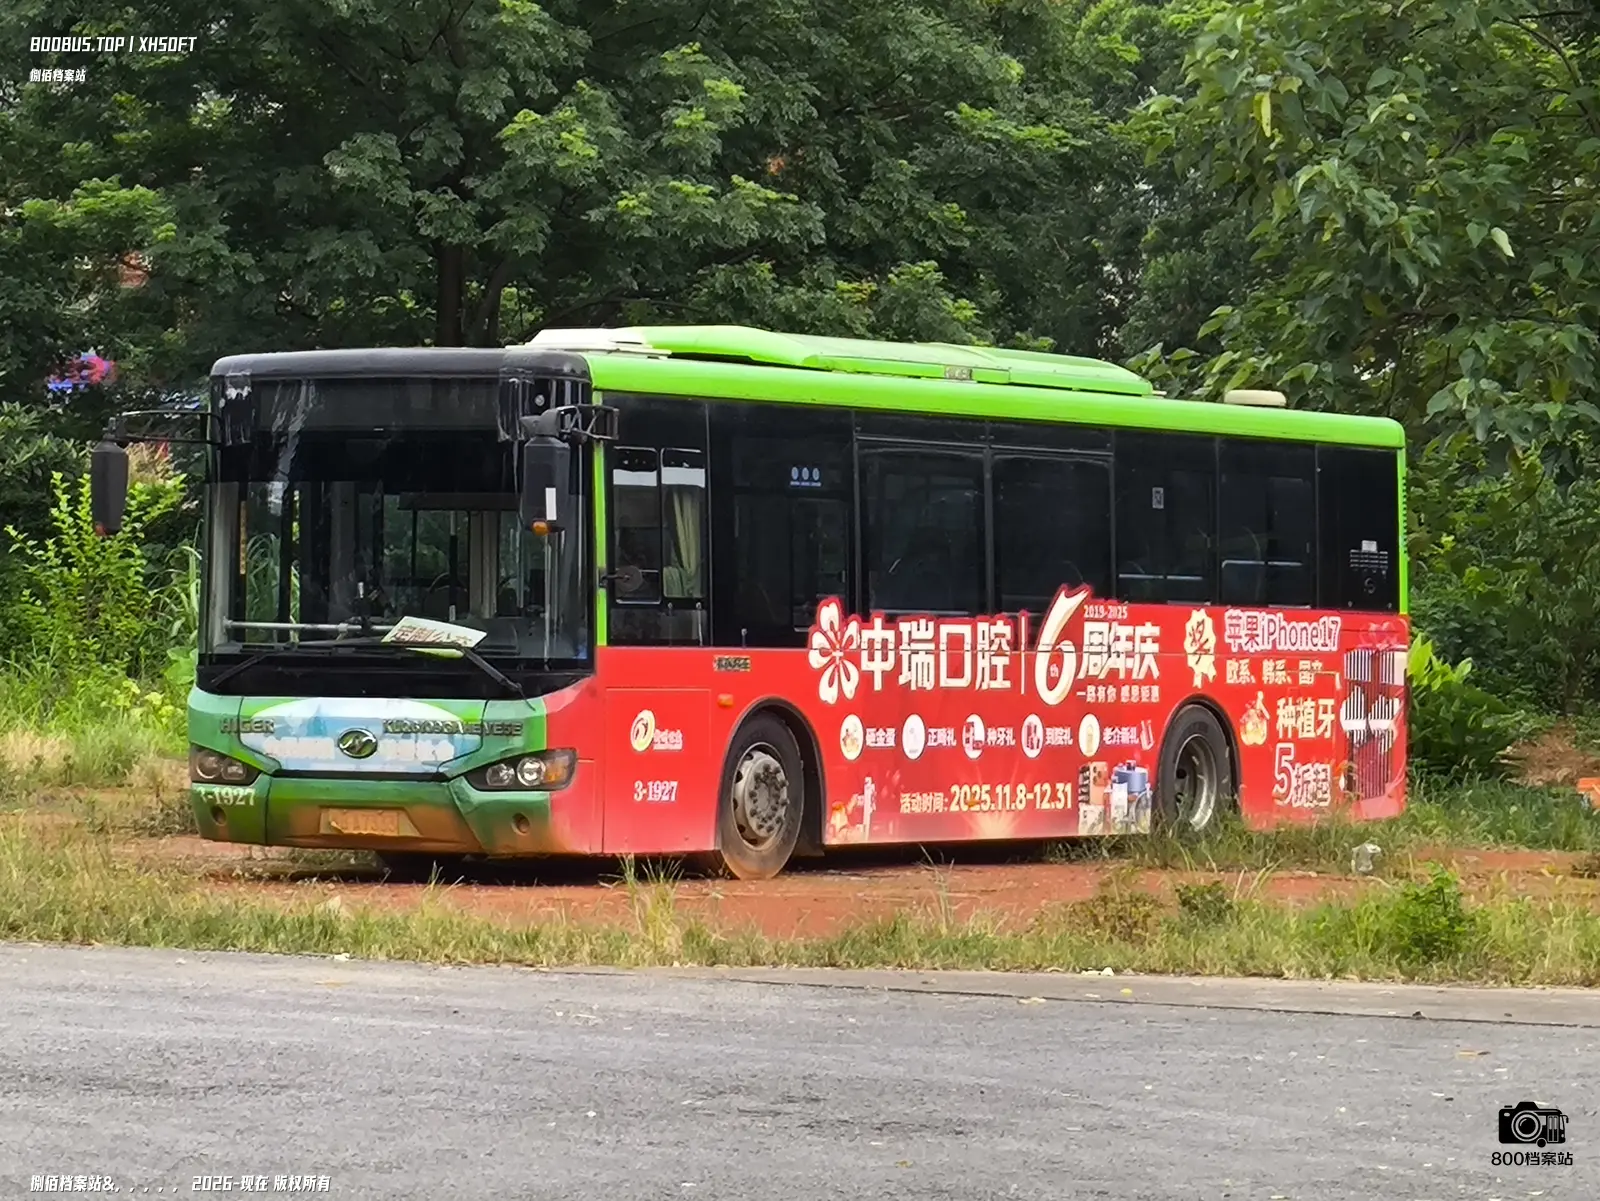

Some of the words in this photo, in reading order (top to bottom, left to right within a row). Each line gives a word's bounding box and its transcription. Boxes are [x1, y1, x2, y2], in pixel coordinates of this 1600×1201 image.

[1084, 604, 1128, 619] 2019-2025
[1226, 611, 1340, 651] 苹果iPhone17
[861, 617, 1011, 691] 中瑞口腔
[221, 718, 276, 734] HIGER
[1276, 698, 1335, 738] 种植牙
[633, 781, 678, 802] 3-1927
[1272, 743, 1331, 807] 5折起
